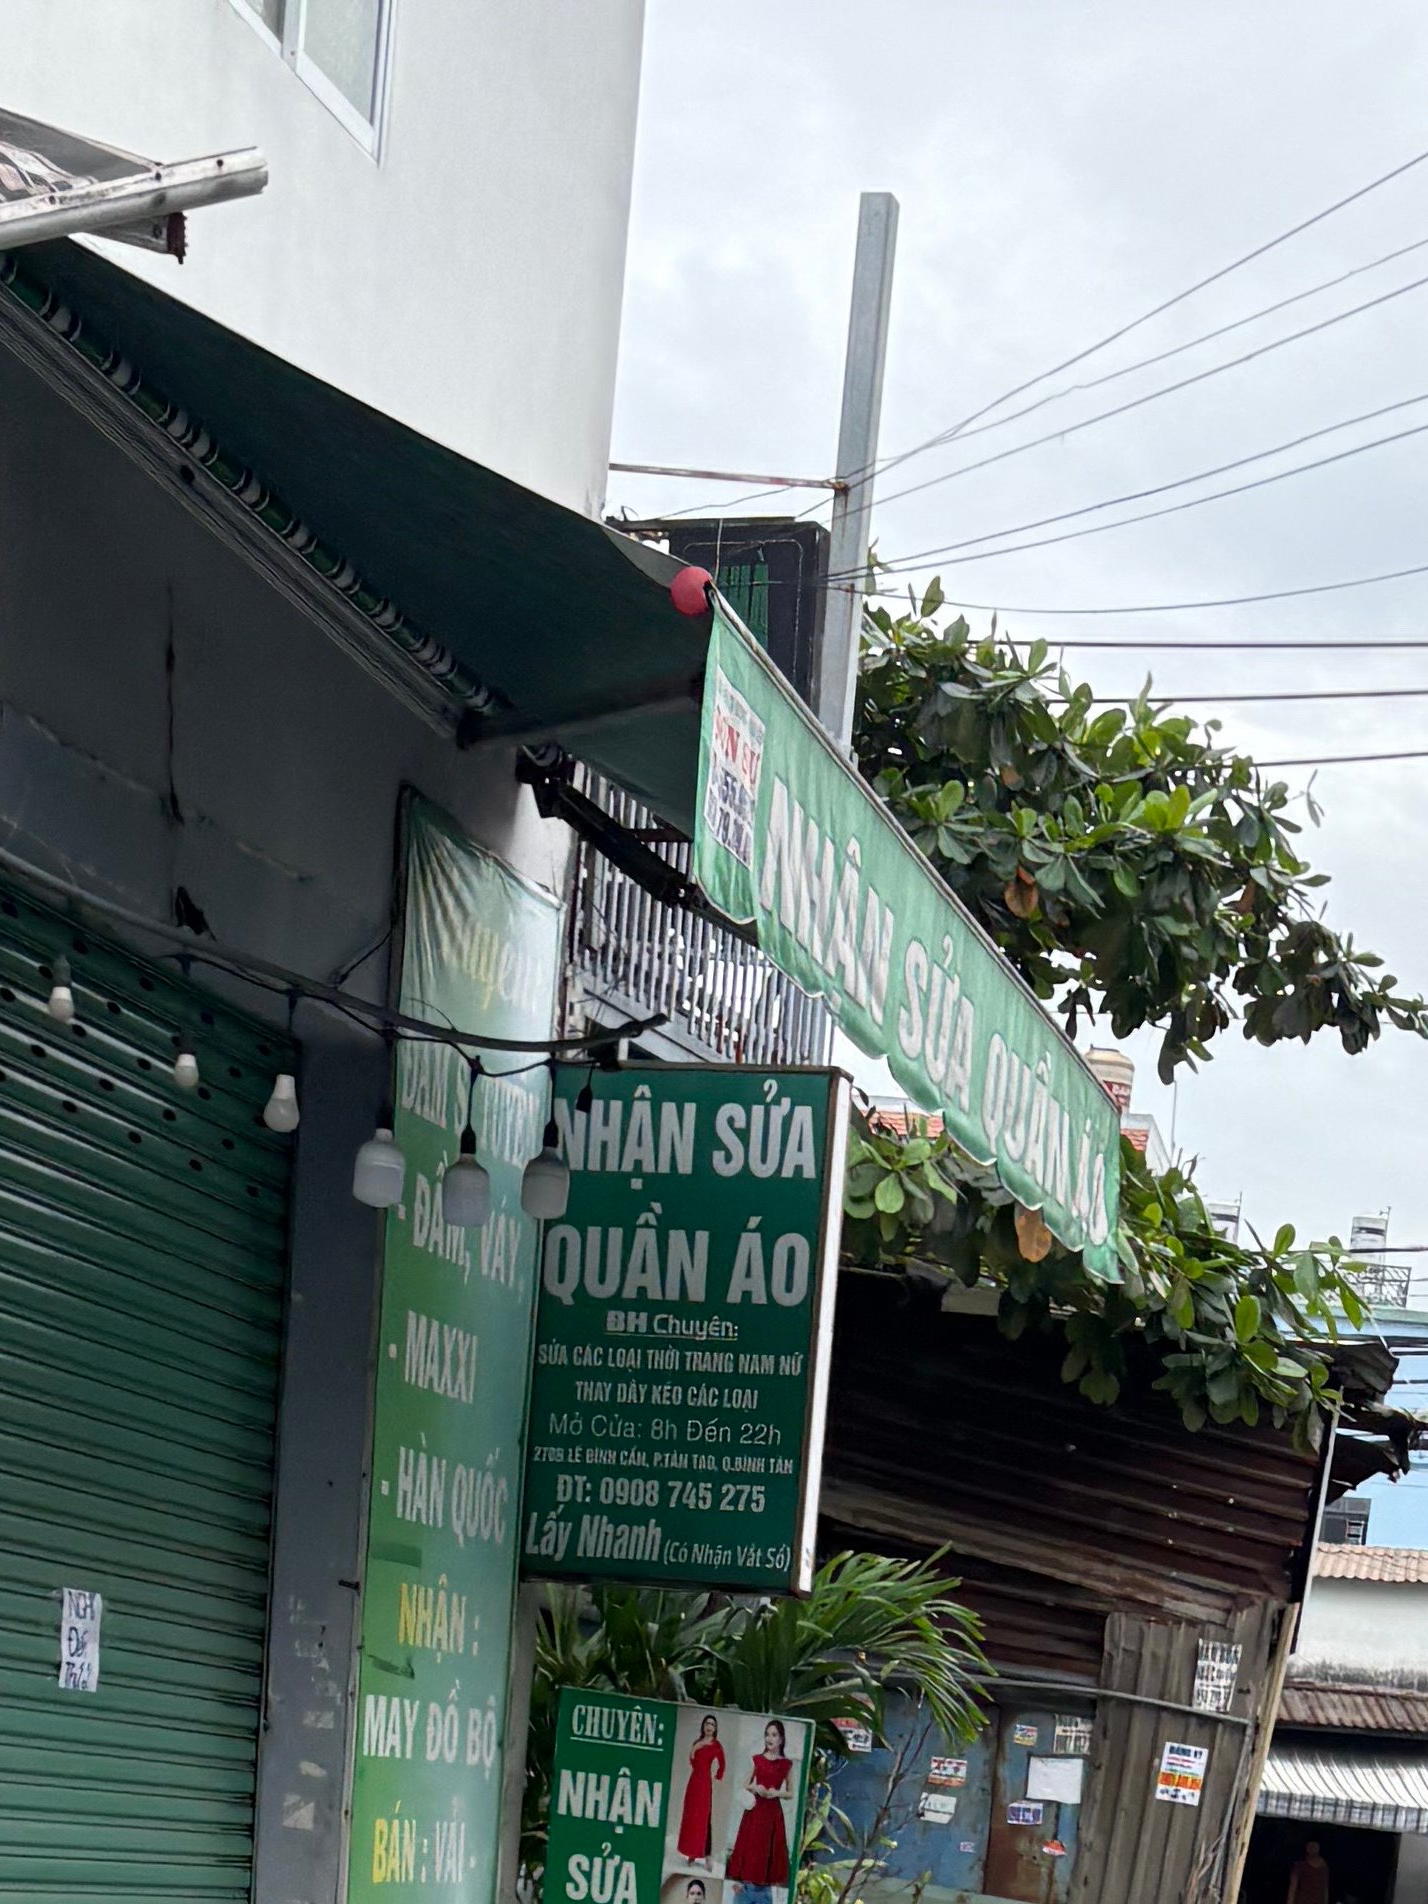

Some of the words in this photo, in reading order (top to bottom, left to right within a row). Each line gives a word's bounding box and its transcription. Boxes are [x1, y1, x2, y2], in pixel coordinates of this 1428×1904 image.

[760, 775, 894, 1027] NHẬN
[898, 934, 974, 1113] SỬA
[554, 1084, 697, 1190] NHẬN
[712, 1078, 817, 1179] SỬA
[543, 1201, 710, 1305] QUẦN
[726, 1215, 811, 1307] ÁO
[404, 1309, 478, 1403] MAXXI
[537, 1337, 568, 1366] SỬA
[572, 1341, 603, 1367] CÁC
[607, 1348, 641, 1373] LOẠI
[646, 1344, 680, 1371] THỜI
[685, 1351, 734, 1374] TRANG
[738, 1354, 775, 1375] NAM
[779, 1350, 803, 1376] NỮ
[653, 1314, 739, 1341] Chuyên:
[548, 1411, 583, 1436] Mở
[590, 1414, 642, 1440] Cửa:
[650, 1418, 678, 1441] 8h
[686, 1417, 731, 1443] Đến
[739, 1423, 782, 1447] 22h
[575, 1380, 612, 1402] THAY
[651, 1381, 682, 1406] KÉO
[687, 1382, 719, 1408] CÁC
[723, 1389, 759, 1413] LOẠI
[396, 1431, 446, 1528] HÀN
[451, 1447, 510, 1549] QUỐC
[556, 1473, 592, 1503] ĐT:
[599, 1477, 660, 1508] 0908
[668, 1480, 713, 1510] 745
[719, 1484, 766, 1513] 275
[525, 1504, 572, 1562] Lấy
[576, 1513, 662, 1562] Nhanh
[663, 1538, 686, 1566] (Có
[690, 1543, 733, 1571] Nhận
[363, 1694, 420, 1760] MAY
[466, 1695, 497, 1780] BỘ
[572, 1704, 665, 1746] CHUYÊN:
[557, 1766, 663, 1834] NHẬN
